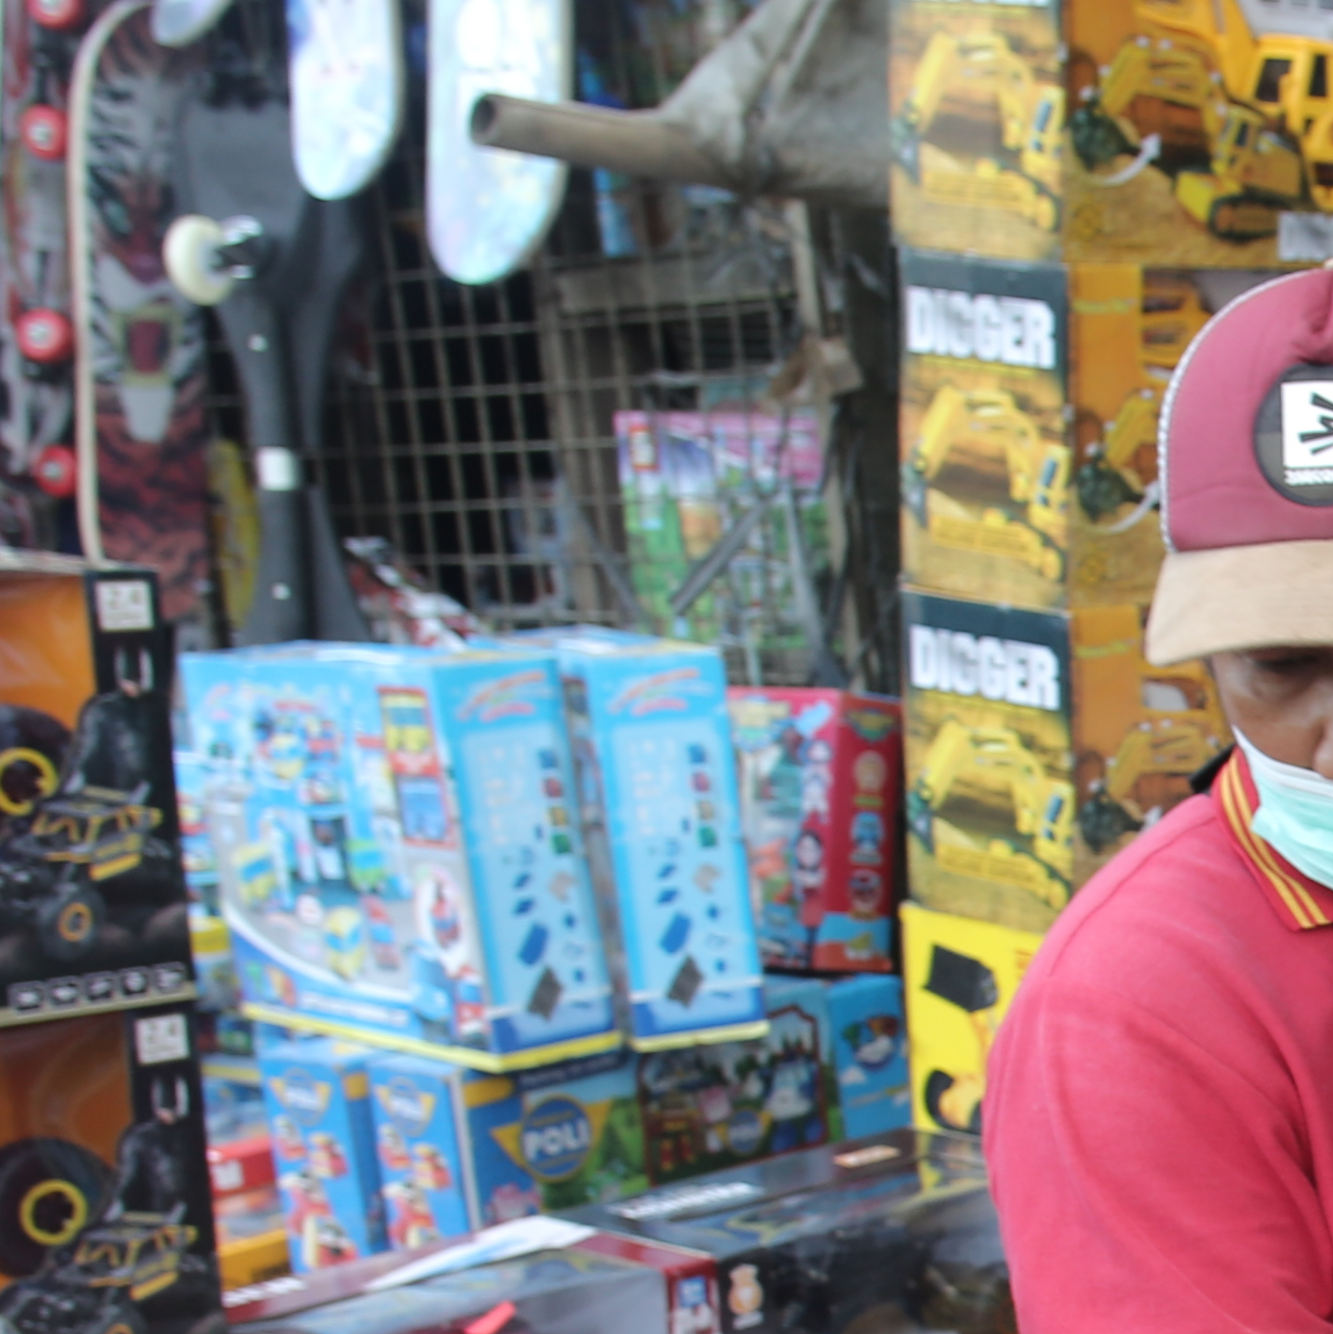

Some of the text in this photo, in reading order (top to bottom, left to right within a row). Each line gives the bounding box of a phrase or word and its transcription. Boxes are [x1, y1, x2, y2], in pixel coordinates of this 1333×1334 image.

[906, 286, 1057, 369] DIGGER
[909, 623, 1061, 712] DIGGER
[522, 1120, 590, 1159] POLI
